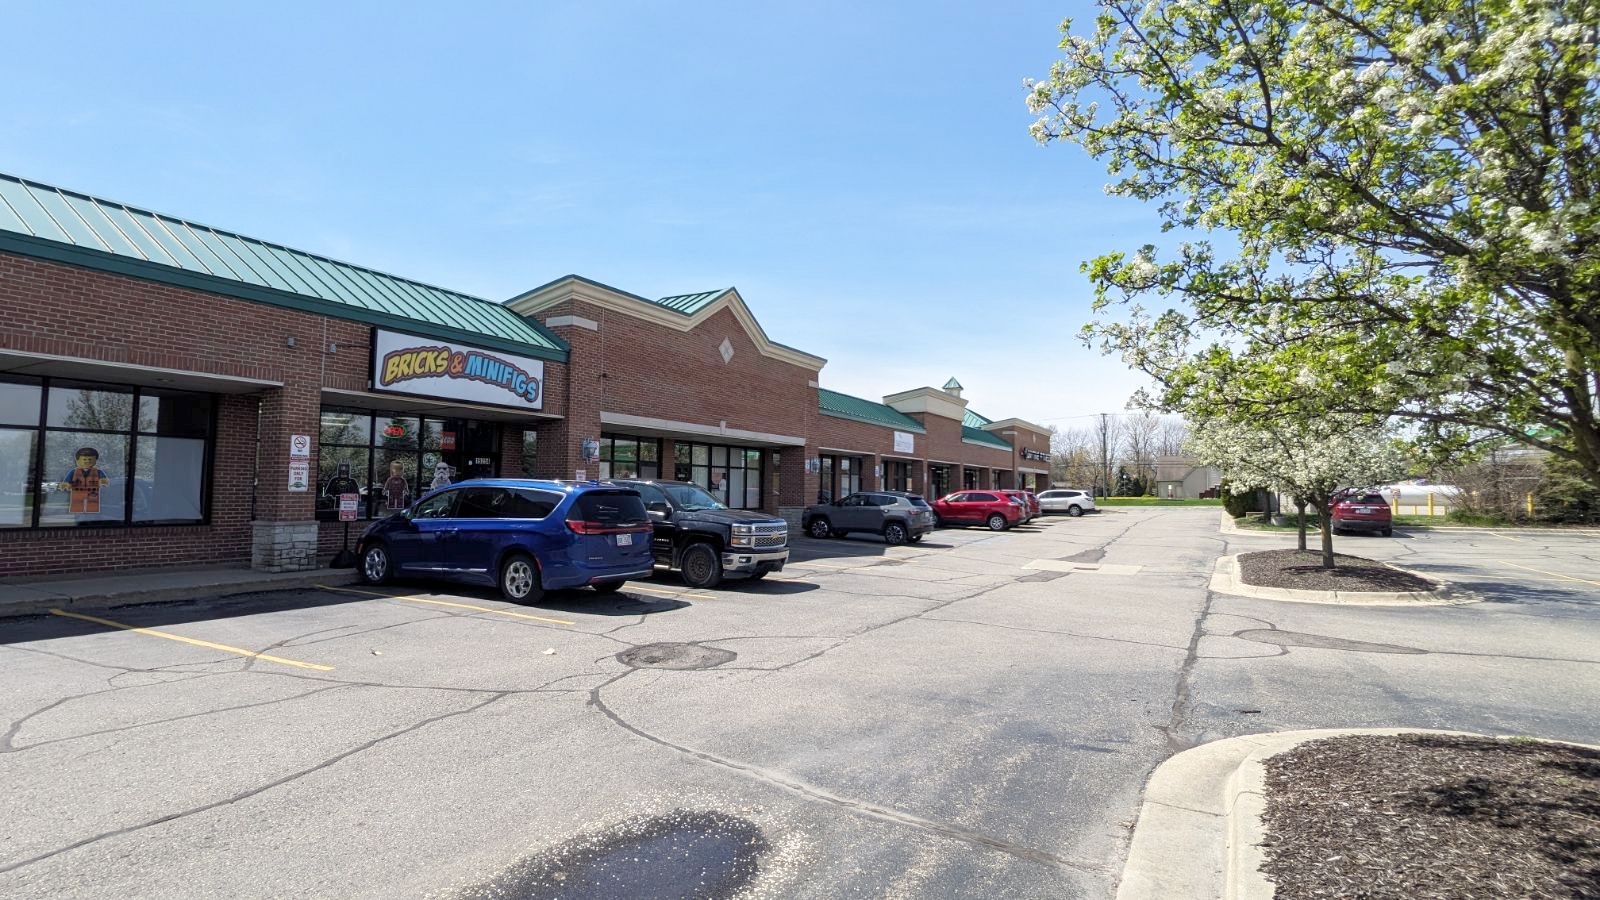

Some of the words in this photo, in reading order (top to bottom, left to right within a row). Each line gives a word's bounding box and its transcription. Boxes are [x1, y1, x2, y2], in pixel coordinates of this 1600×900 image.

[384, 350, 450, 382] BRICKS
[450, 353, 464, 375] &
[464, 354, 538, 400] MINIFIGS
